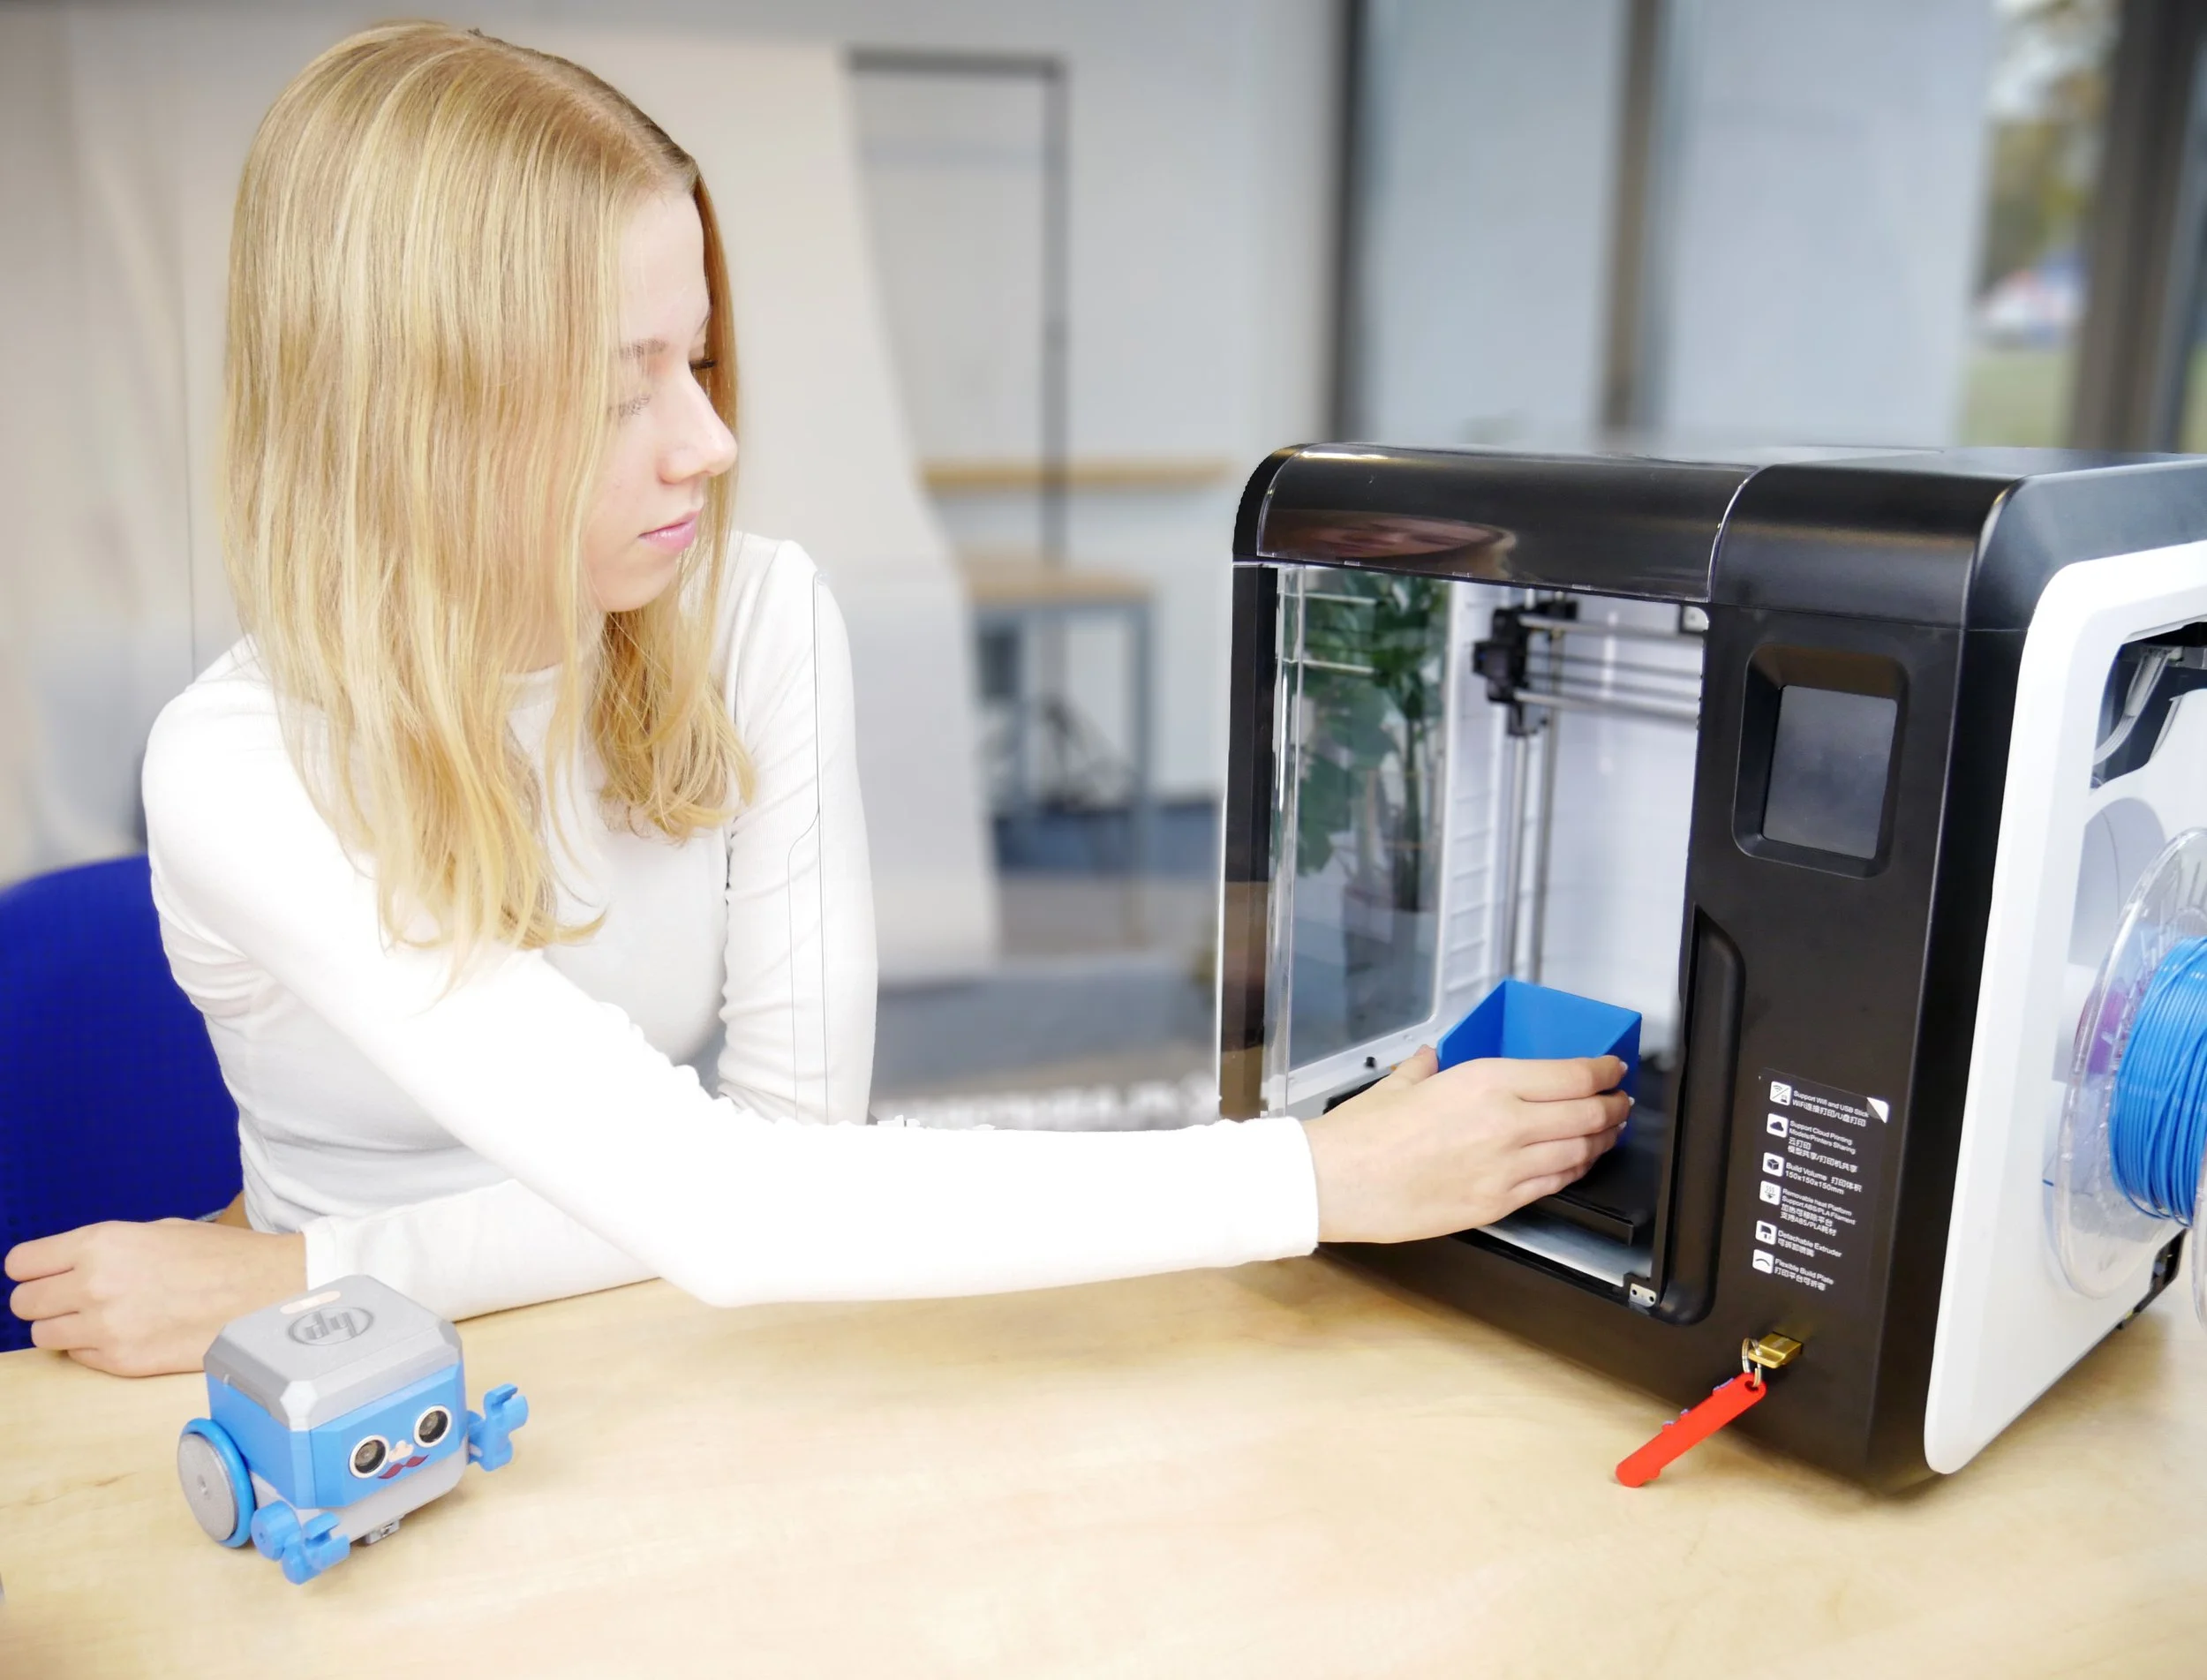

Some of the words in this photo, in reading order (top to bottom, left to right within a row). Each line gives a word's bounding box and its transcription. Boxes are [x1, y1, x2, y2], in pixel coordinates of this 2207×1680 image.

[1793, 1090, 1816, 1102] Support
[1839, 1104, 1854, 1113] USB
[1853, 1108, 1869, 1118] Stick
[1789, 1120, 1812, 1132] Support
[1812, 1127, 1830, 1138] Cloud
[1829, 1133, 1853, 1146] Printing
[1789, 1136, 1812, 1150] 云打印
[1833, 1141, 1856, 1155] Sharing
[1785, 1170, 1844, 1194] 150x150x150mm
[1786, 1162, 1803, 1172] Build
[1803, 1167, 1827, 1181] Volume
[1781, 1195, 1804, 1208] Support
[1830, 1211, 1856, 1225] Filament
[1782, 1188, 1814, 1203] Removable
[1827, 1203, 1852, 1217] Platform
[1777, 1230, 1814, 1247] Detachable
[1813, 1242, 1842, 1257] Extruder
[1774, 1258, 1799, 1272] Flexible
[1799, 1267, 1817, 1278] Build
[1817, 1273, 1834, 1284] Plate
[305, 1311, 357, 1340] hp
